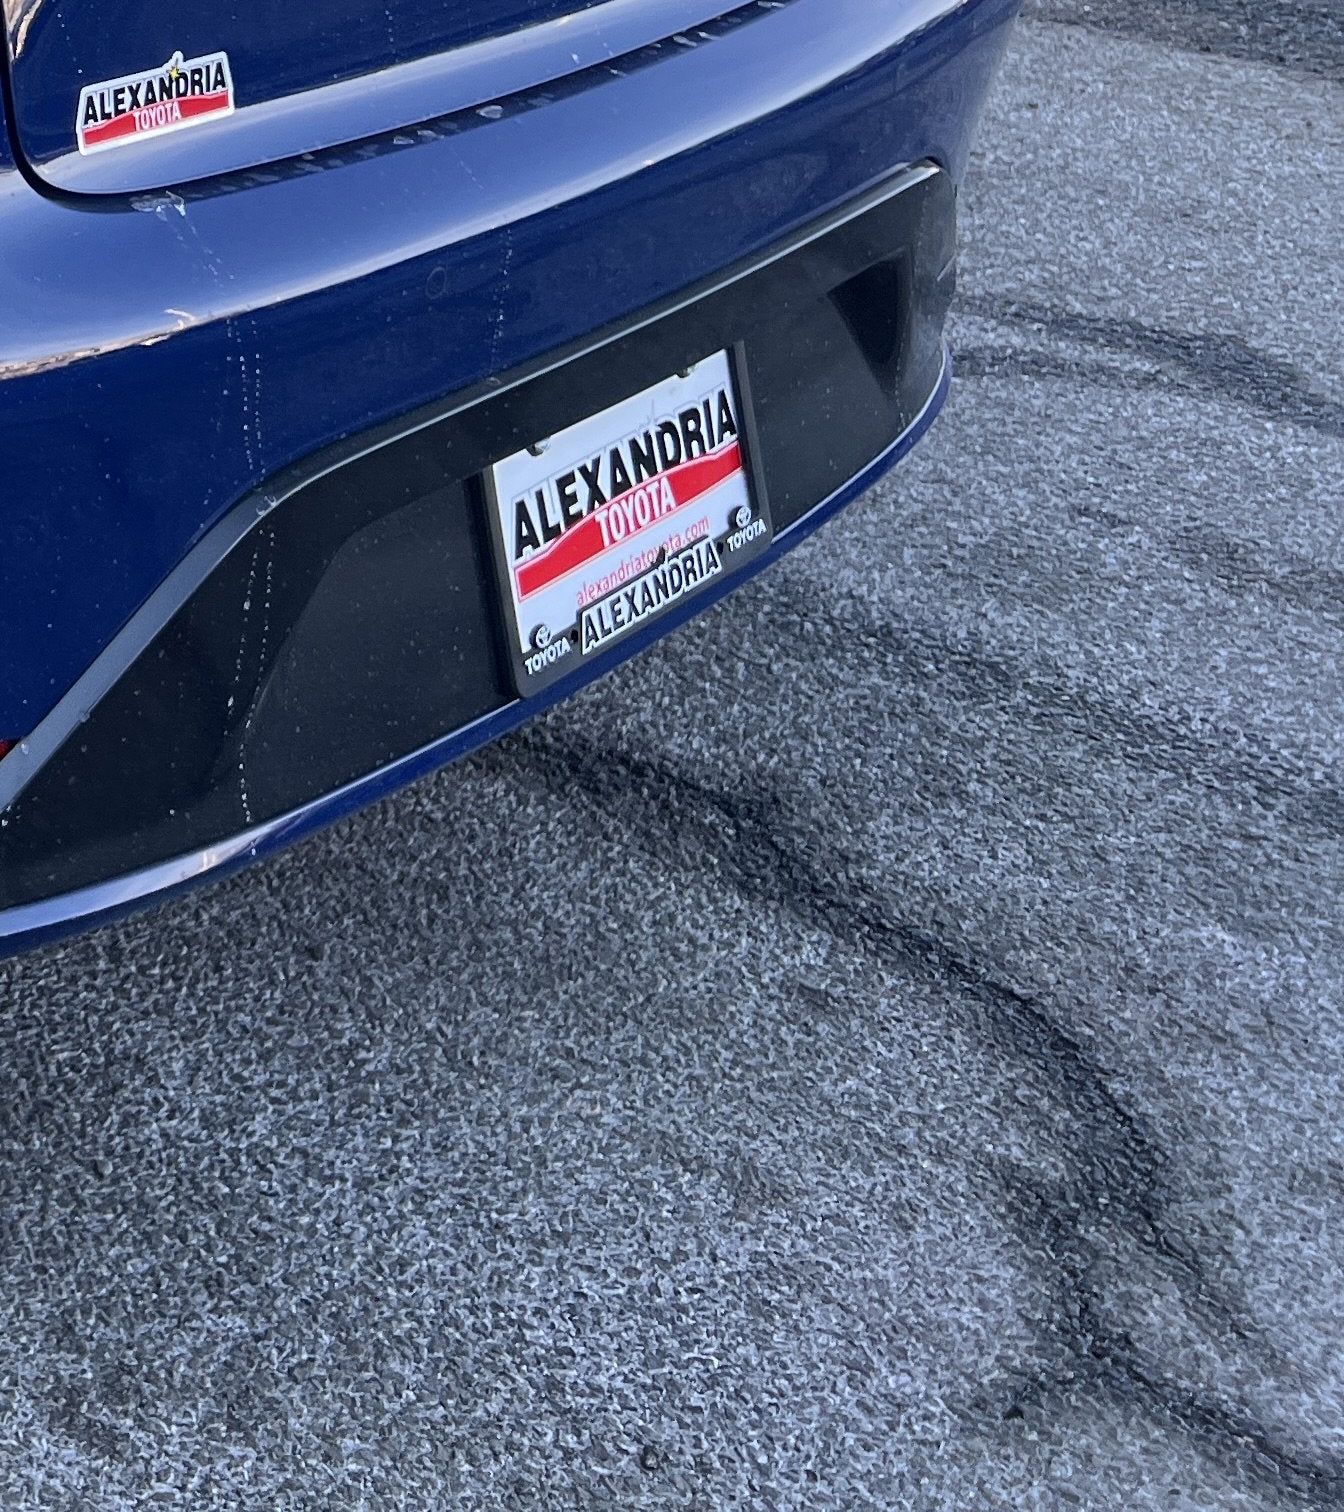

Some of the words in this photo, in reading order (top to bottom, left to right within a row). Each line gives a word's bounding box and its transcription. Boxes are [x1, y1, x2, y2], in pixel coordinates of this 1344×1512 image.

[83, 61, 226, 126] ALEXANDRIA
[132, 101, 182, 132] TOYOTA
[514, 388, 738, 561] ALEXANDRIA
[594, 476, 677, 549] TOYOTA
[727, 518, 768, 553] TOYOTA
[582, 539, 721, 653] ALEXANDRIA
[524, 636, 571, 675] TOYOTA
